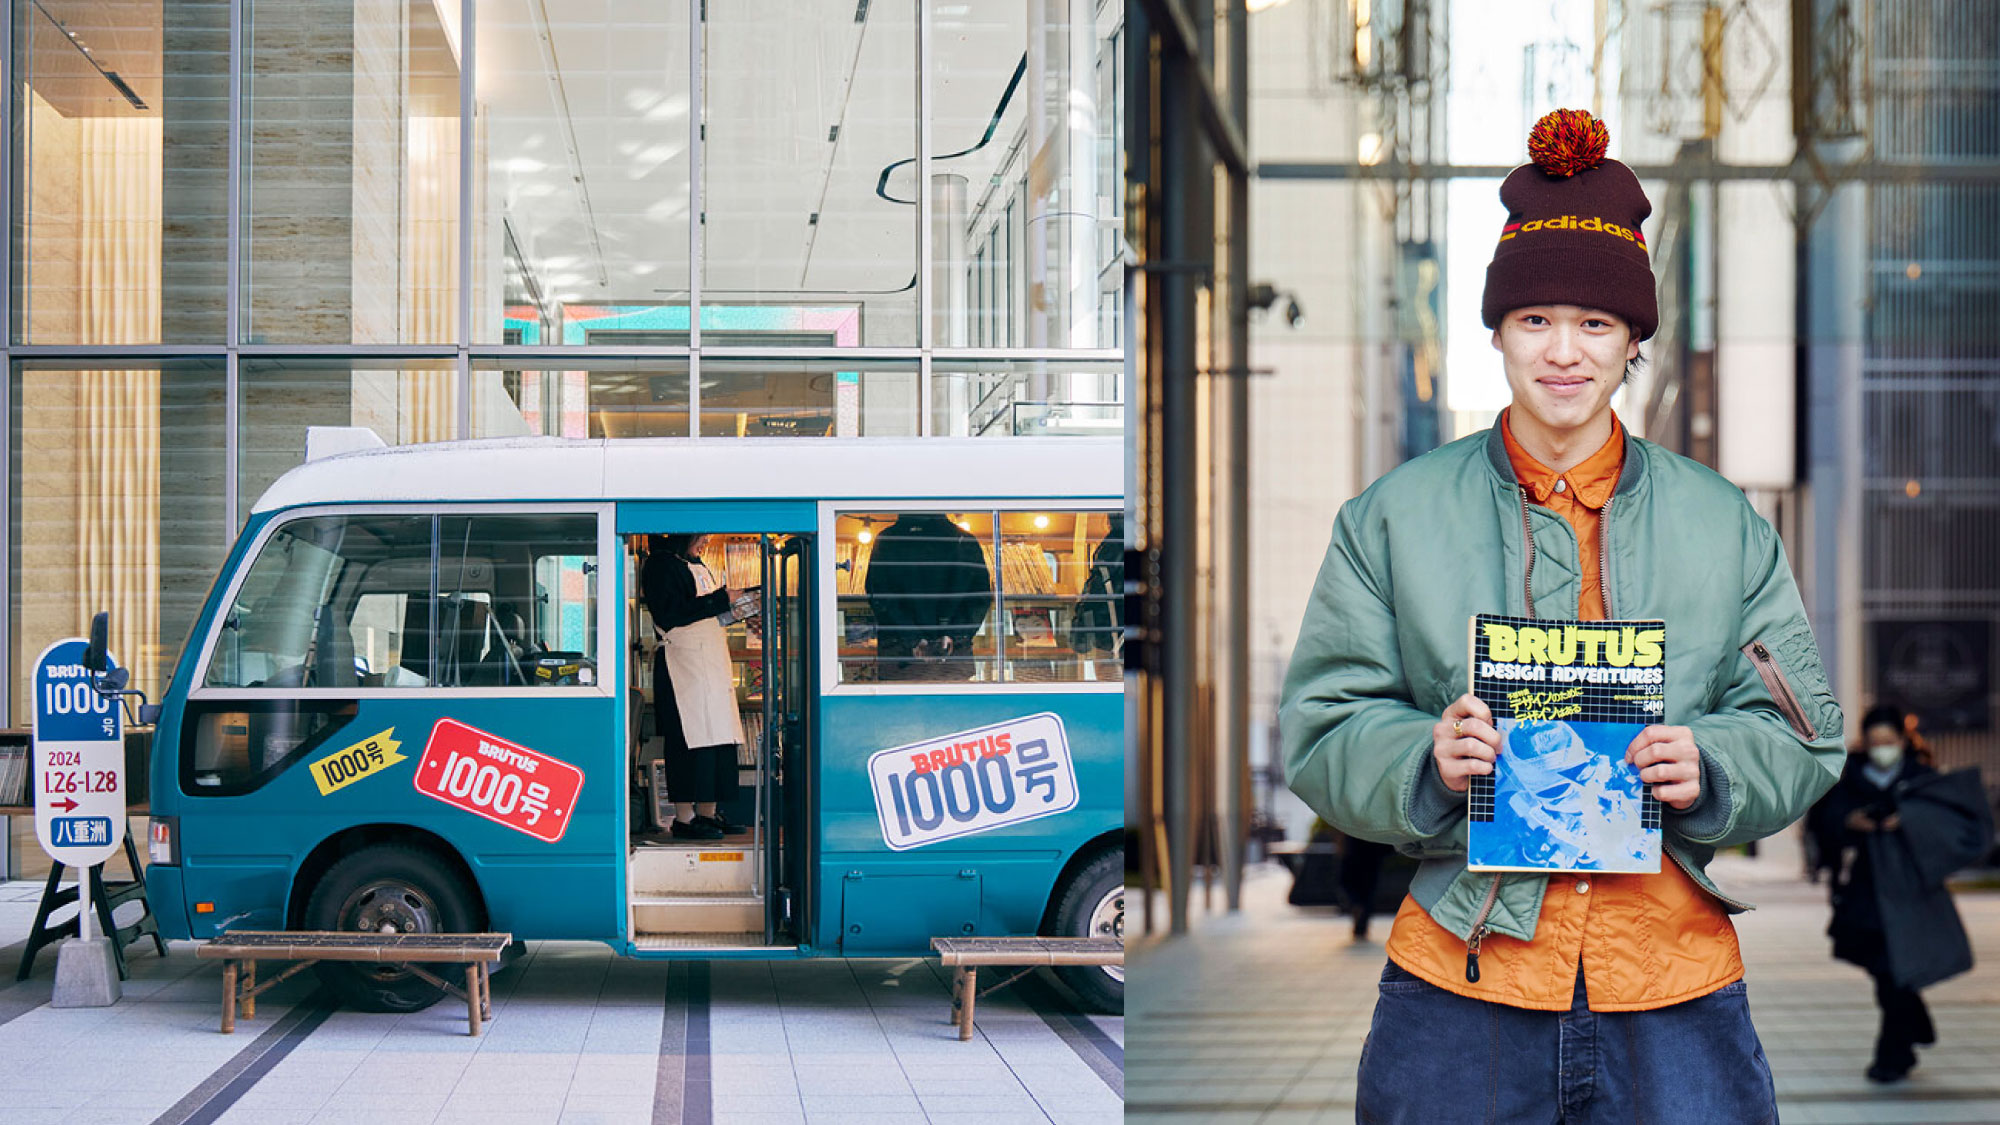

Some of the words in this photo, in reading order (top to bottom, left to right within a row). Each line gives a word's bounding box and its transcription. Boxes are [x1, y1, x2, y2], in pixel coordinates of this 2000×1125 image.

[1521, 215, 1635, 242] adidas
[1482, 623, 1665, 668] BRUTUS
[46, 664, 107, 678] BRUT
[1481, 662, 1546, 681] DESIGN
[1552, 665, 1663, 684] ADVENTURES
[1643, 700, 1664, 711] 500
[48, 751, 81, 766] 2024
[478, 740, 540, 774] BRUTUS
[911, 733, 1011, 775] BRUTUS
[45, 770, 118, 794] 1.26-1.28
[56, 820, 107, 843] 八重洲
